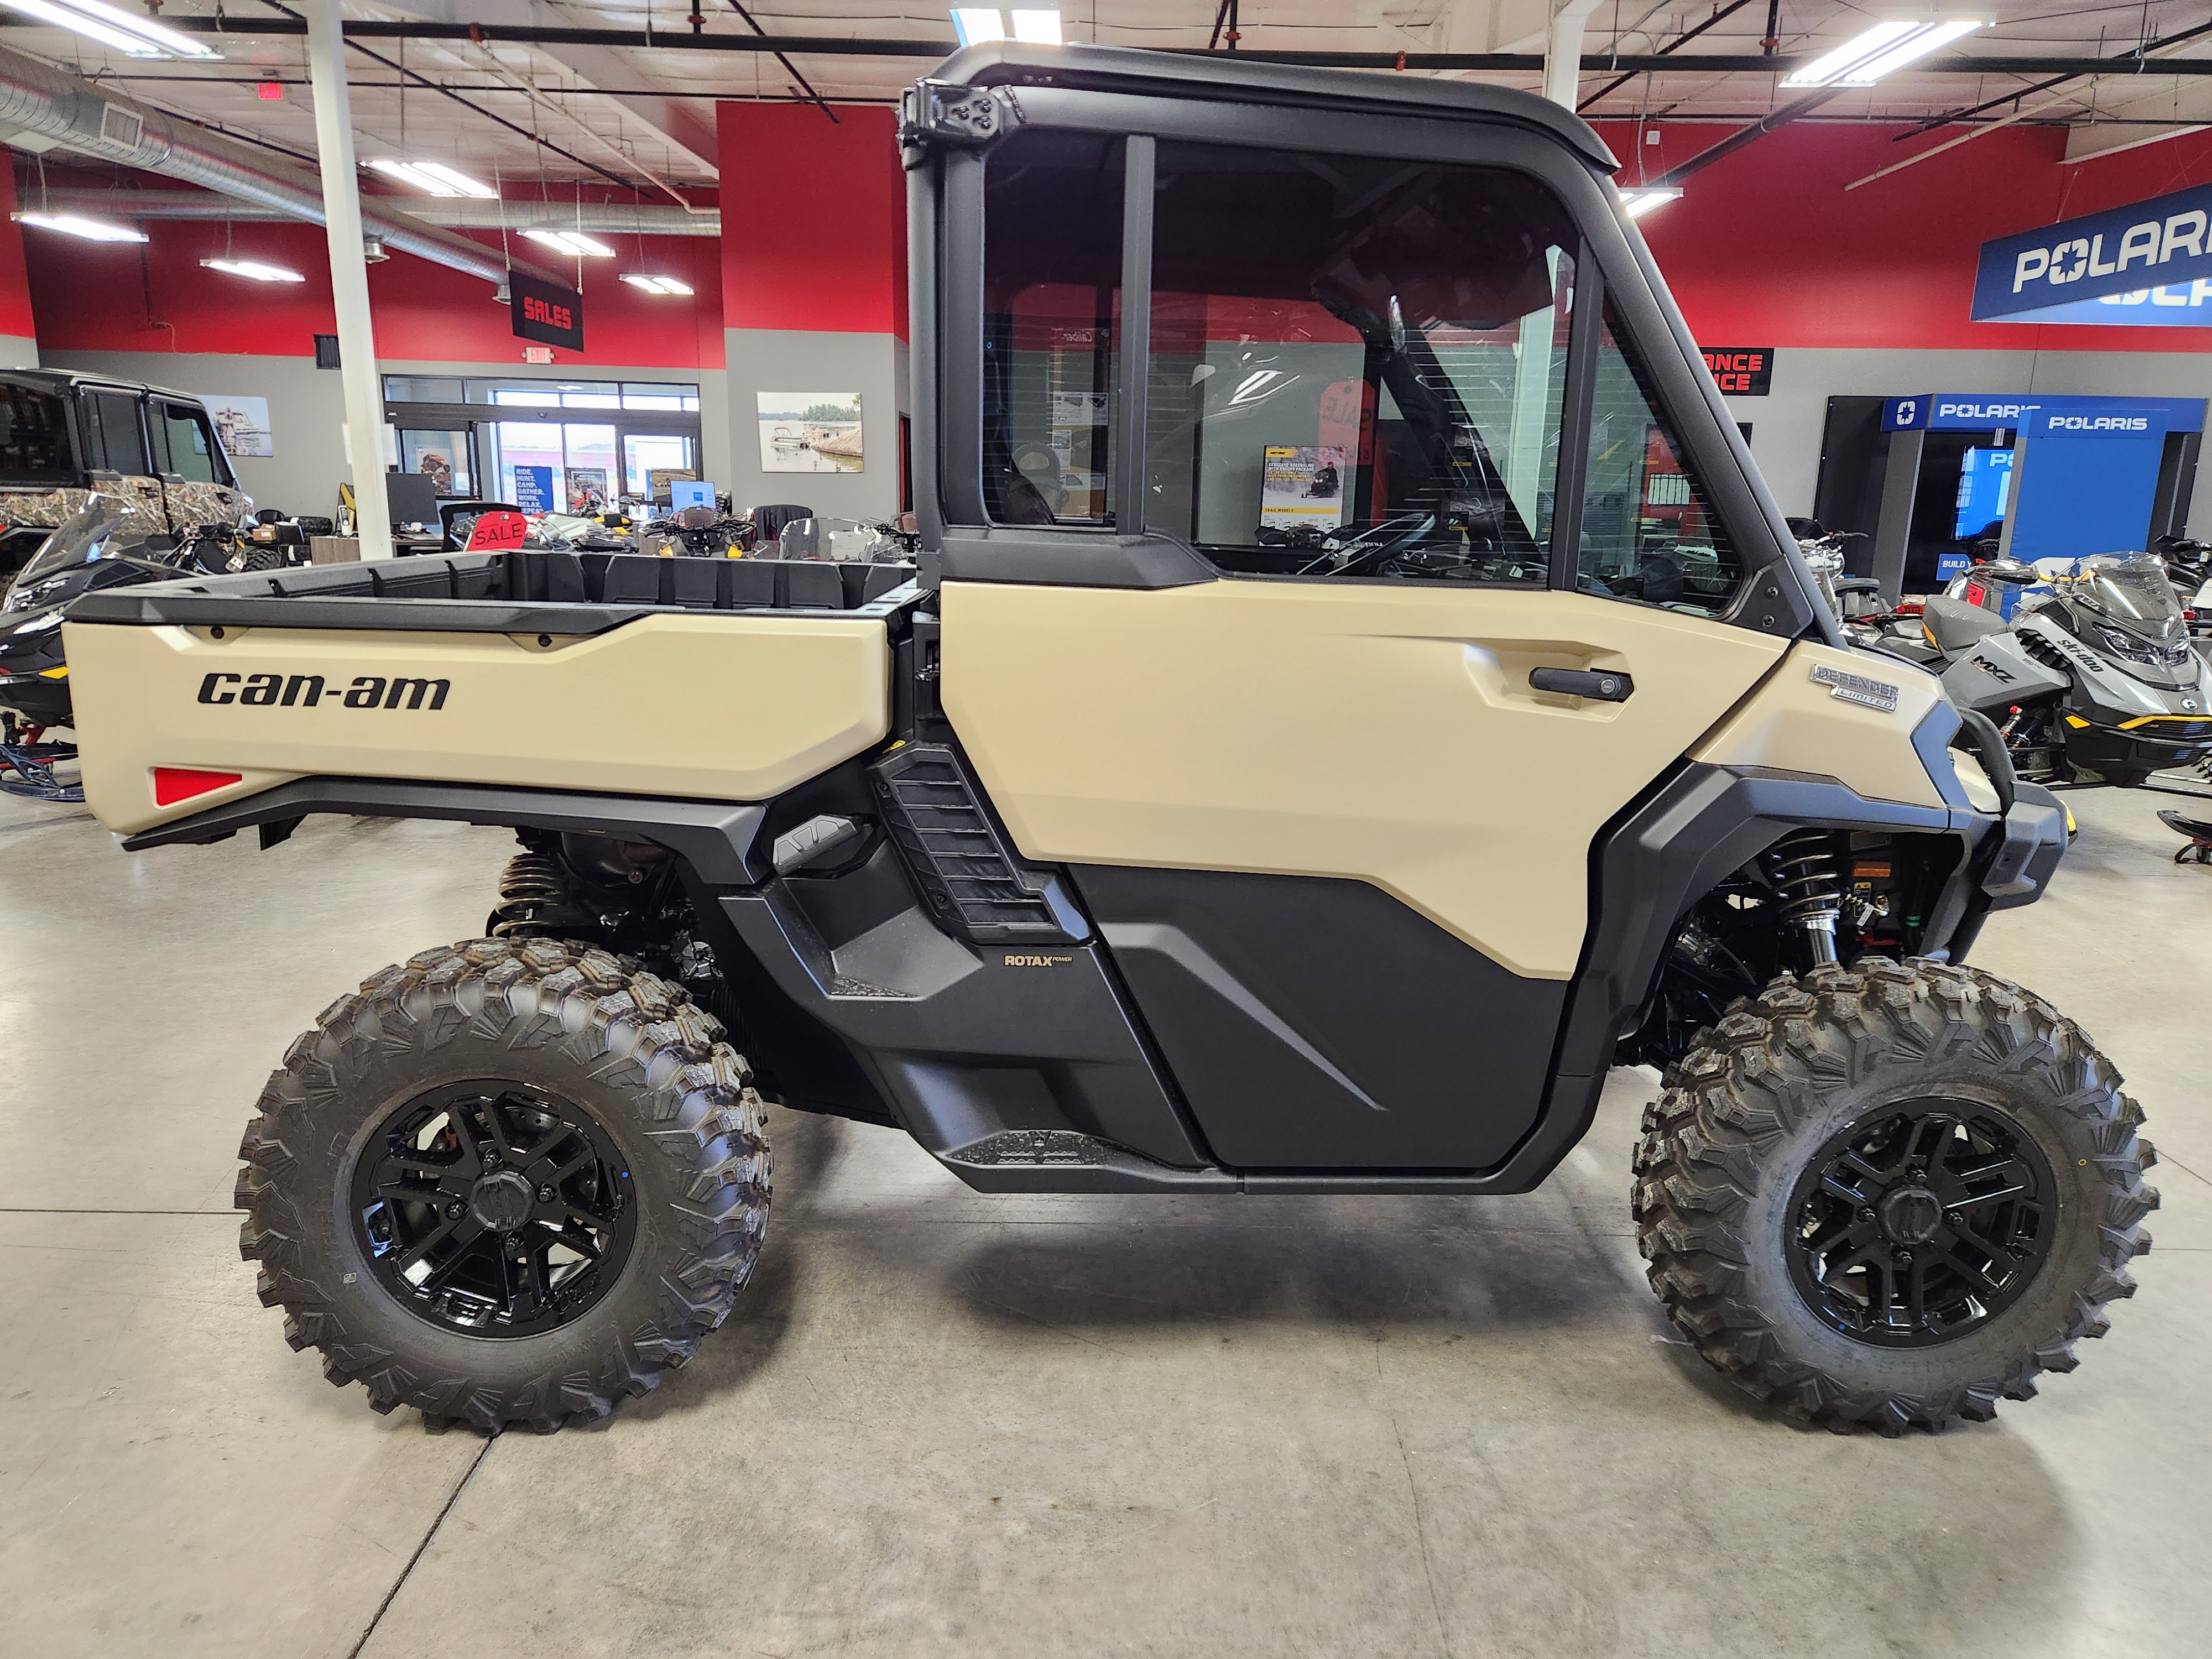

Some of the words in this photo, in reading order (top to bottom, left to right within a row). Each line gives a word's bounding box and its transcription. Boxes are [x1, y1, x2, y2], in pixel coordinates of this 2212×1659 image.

[524, 296, 572, 330] SALES
[531, 349, 546, 361] EXIT
[2048, 417, 2147, 430] POLARIS
[475, 523, 523, 545] SALE
[1971, 655, 2017, 684] MXZ
[197, 673, 451, 710] can-am
[1817, 666, 1899, 701] DEFENDER
[1840, 690, 1893, 708] LIMITED
[1005, 955, 1052, 967] ROTAX
